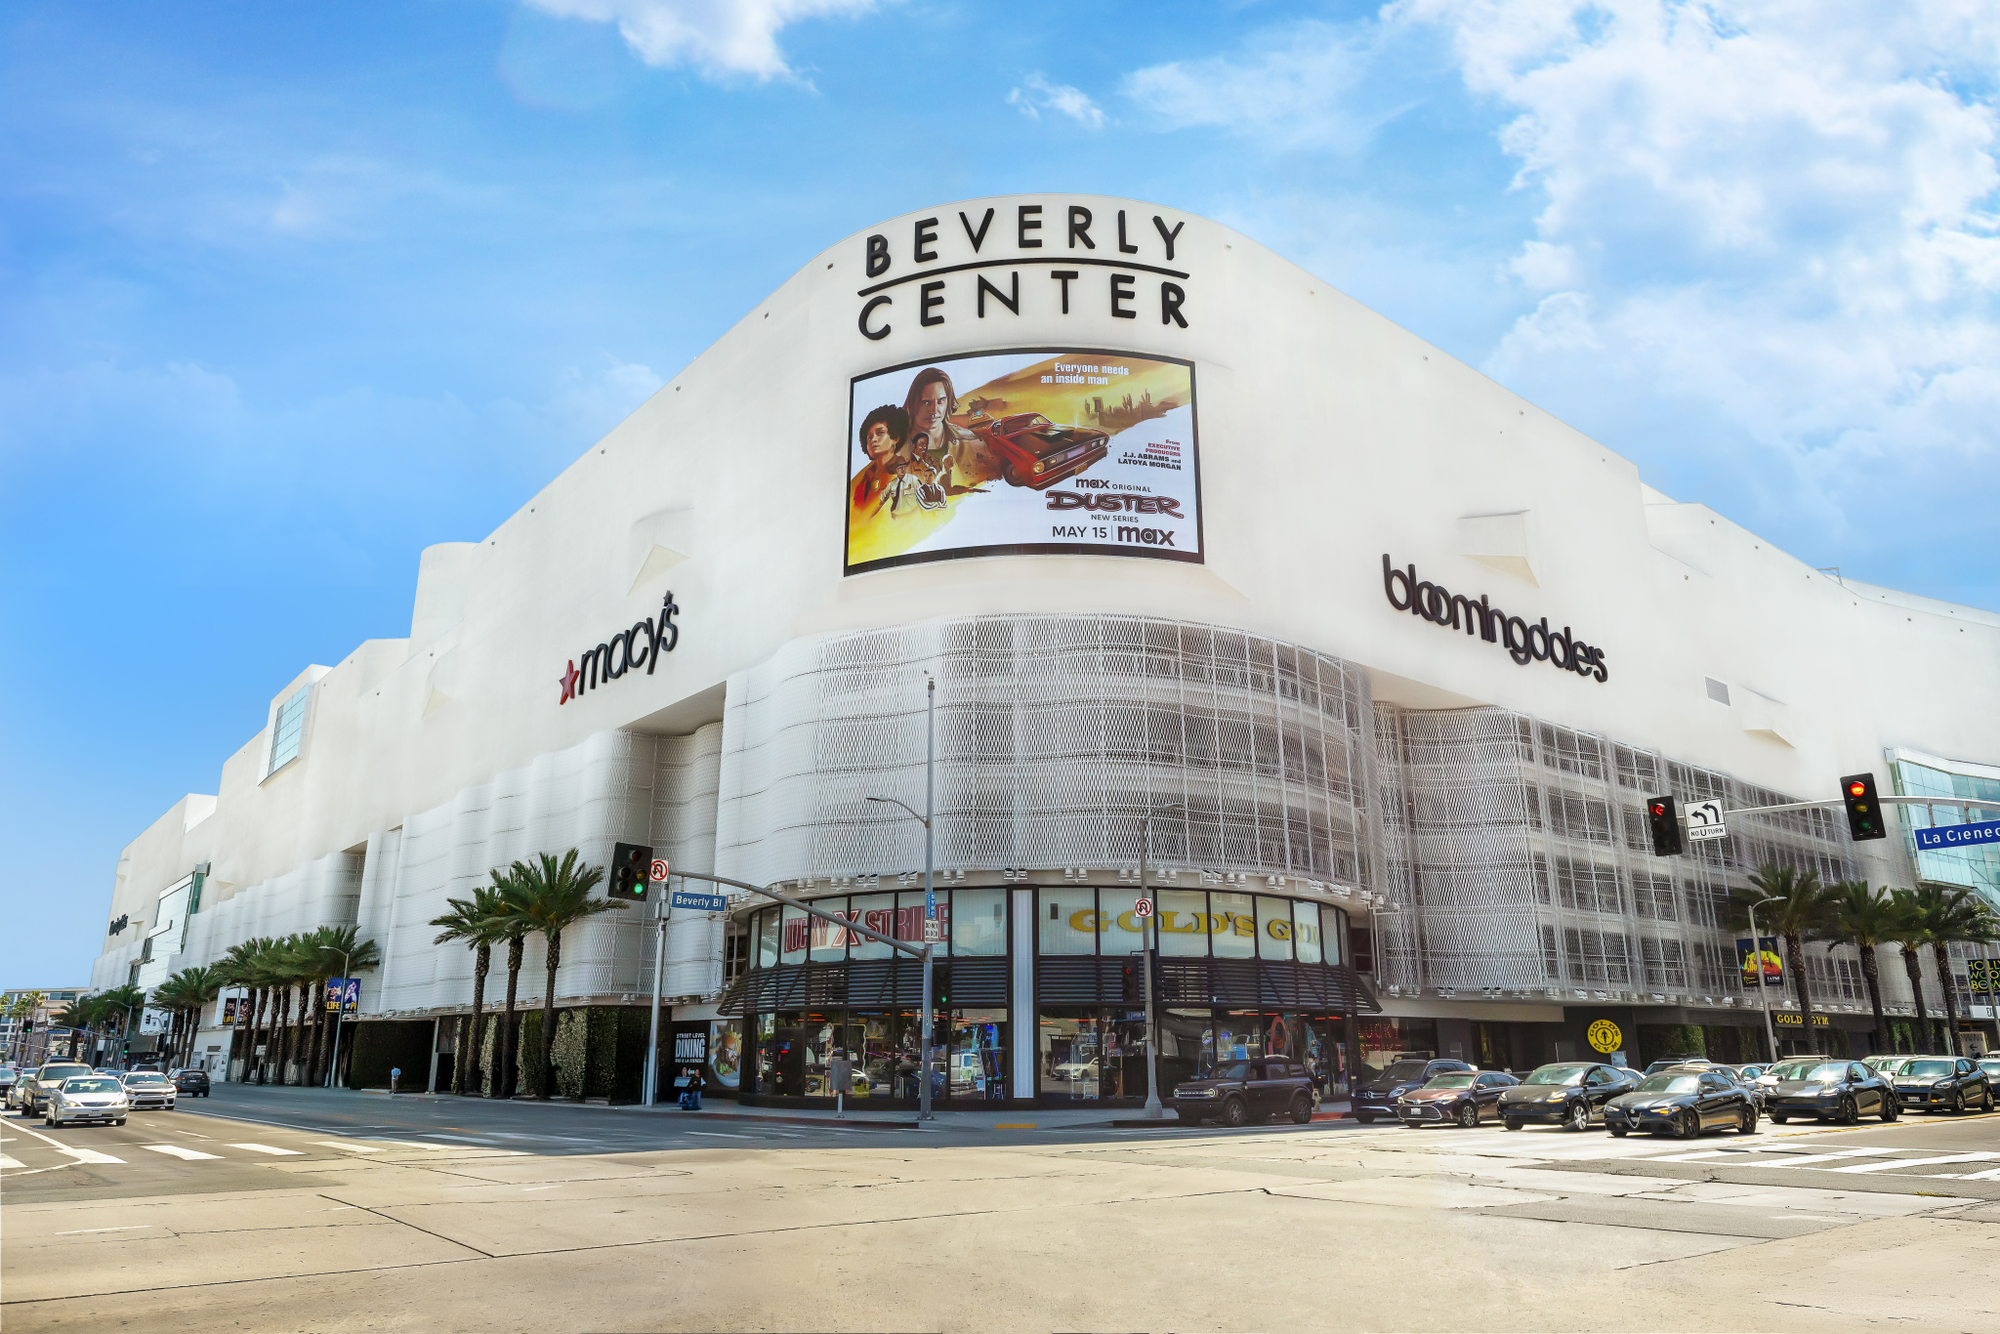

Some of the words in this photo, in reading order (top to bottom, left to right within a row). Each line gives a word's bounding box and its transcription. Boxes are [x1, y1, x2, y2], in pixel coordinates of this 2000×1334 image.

[866, 205, 1185, 278] BEVERLY
[858, 270, 1189, 340] CENTER
[1054, 362, 1098, 374] Everyone
[1102, 365, 1129, 375] needs
[1041, 375, 1053, 384] an
[1056, 374, 1085, 384] inside
[1088, 376, 1108, 385] man
[1145, 448, 1181, 457] PRODUCERS
[1148, 443, 1180, 451] EXECUTIVE
[1137, 453, 1170, 462] ABRAMS
[1118, 458, 1148, 467] LATOYA
[1149, 461, 1181, 471] MORGAN
[1076, 478, 1110, 489] max
[1112, 483, 1152, 493] ORIGINAL
[1045, 490, 1185, 519] DUSTER
[1113, 515, 1139, 523] SERIES
[1052, 525, 1087, 538] MAY
[1092, 526, 1107, 538] 15
[1117, 525, 1175, 547] max
[1700, 828, 1707, 837] U
[1708, 827, 1724, 835] TURN
[1923, 833, 1941, 844] La
[676, 895, 709, 909] Beverly
[713, 898, 722, 907] Bl
[831, 908, 862, 947] X
[1069, 910, 1255, 937] GOLD'S
[1968, 960, 2000, 970] HOLL
[326, 1001, 340, 1009] LIFE
[675, 1038, 706, 1058] DINING
